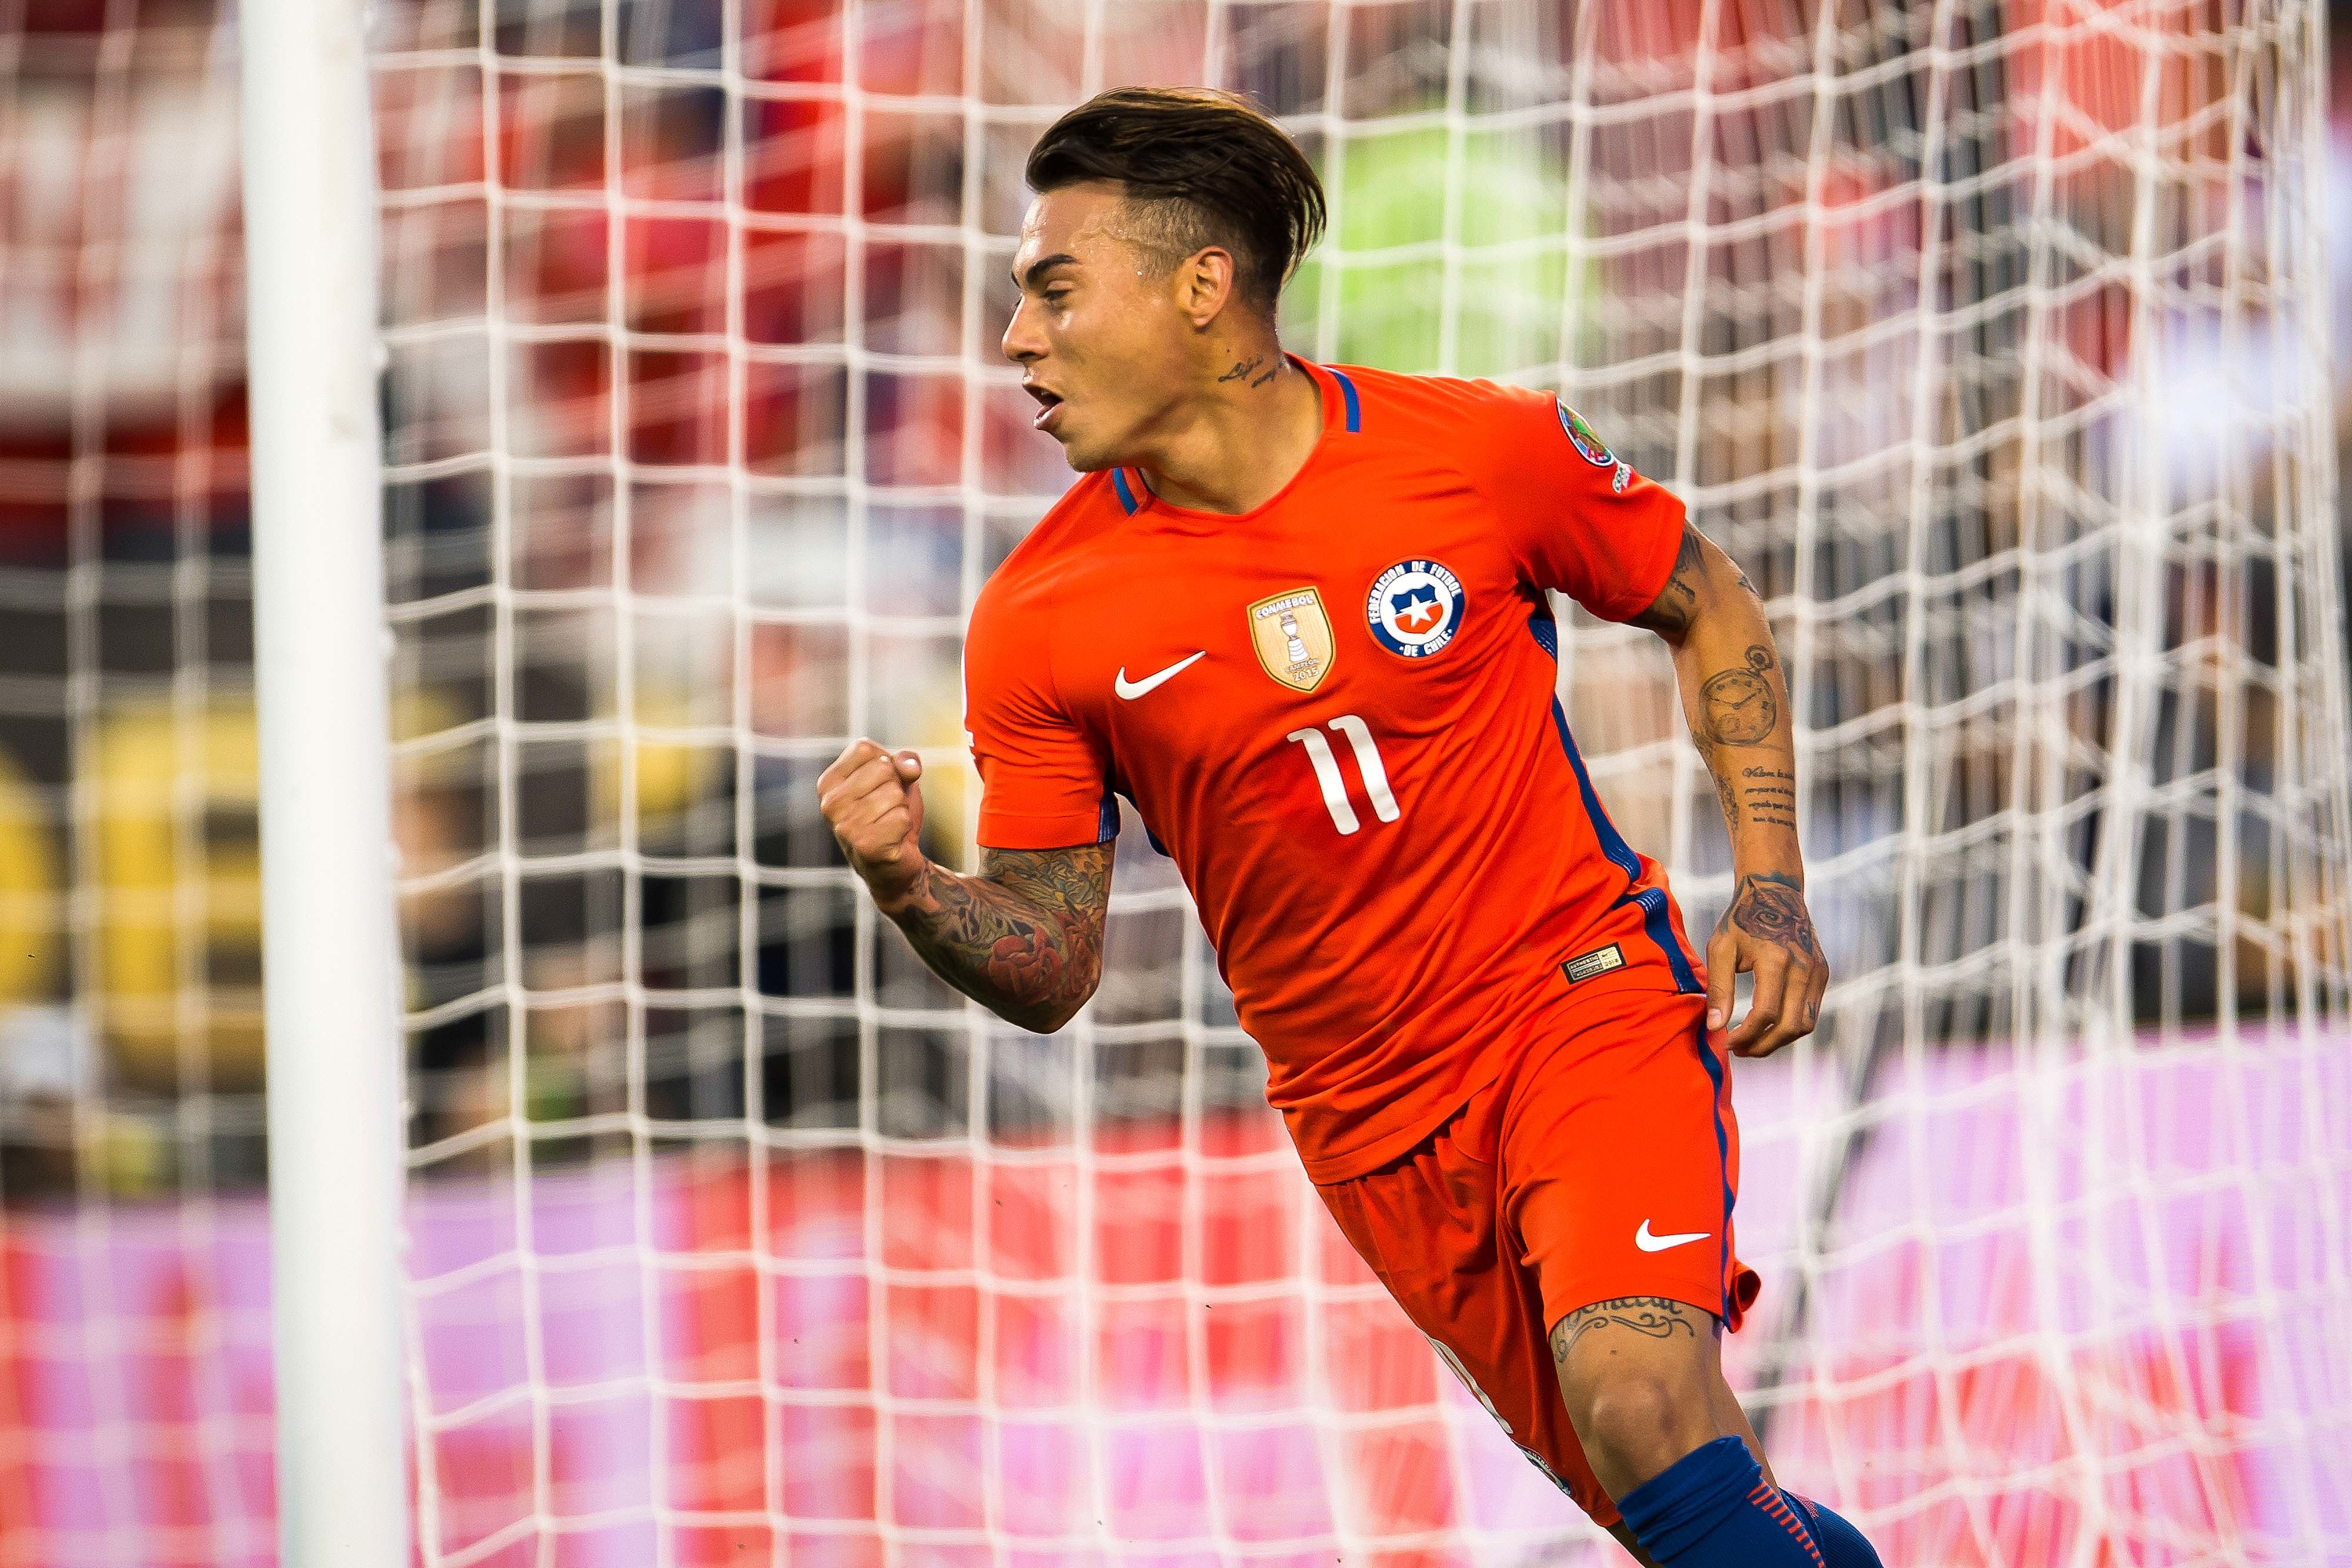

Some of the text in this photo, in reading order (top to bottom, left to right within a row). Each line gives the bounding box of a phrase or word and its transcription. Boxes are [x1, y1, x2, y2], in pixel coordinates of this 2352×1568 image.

[1368, 561, 1462, 624] FEDERACION DE FUTBOL
[1256, 594, 1314, 620] CONMEBOL
[1403, 630, 1451, 657] DE CHILE
[1292, 666, 1318, 682] 2015
[1286, 715, 1401, 835] 11
